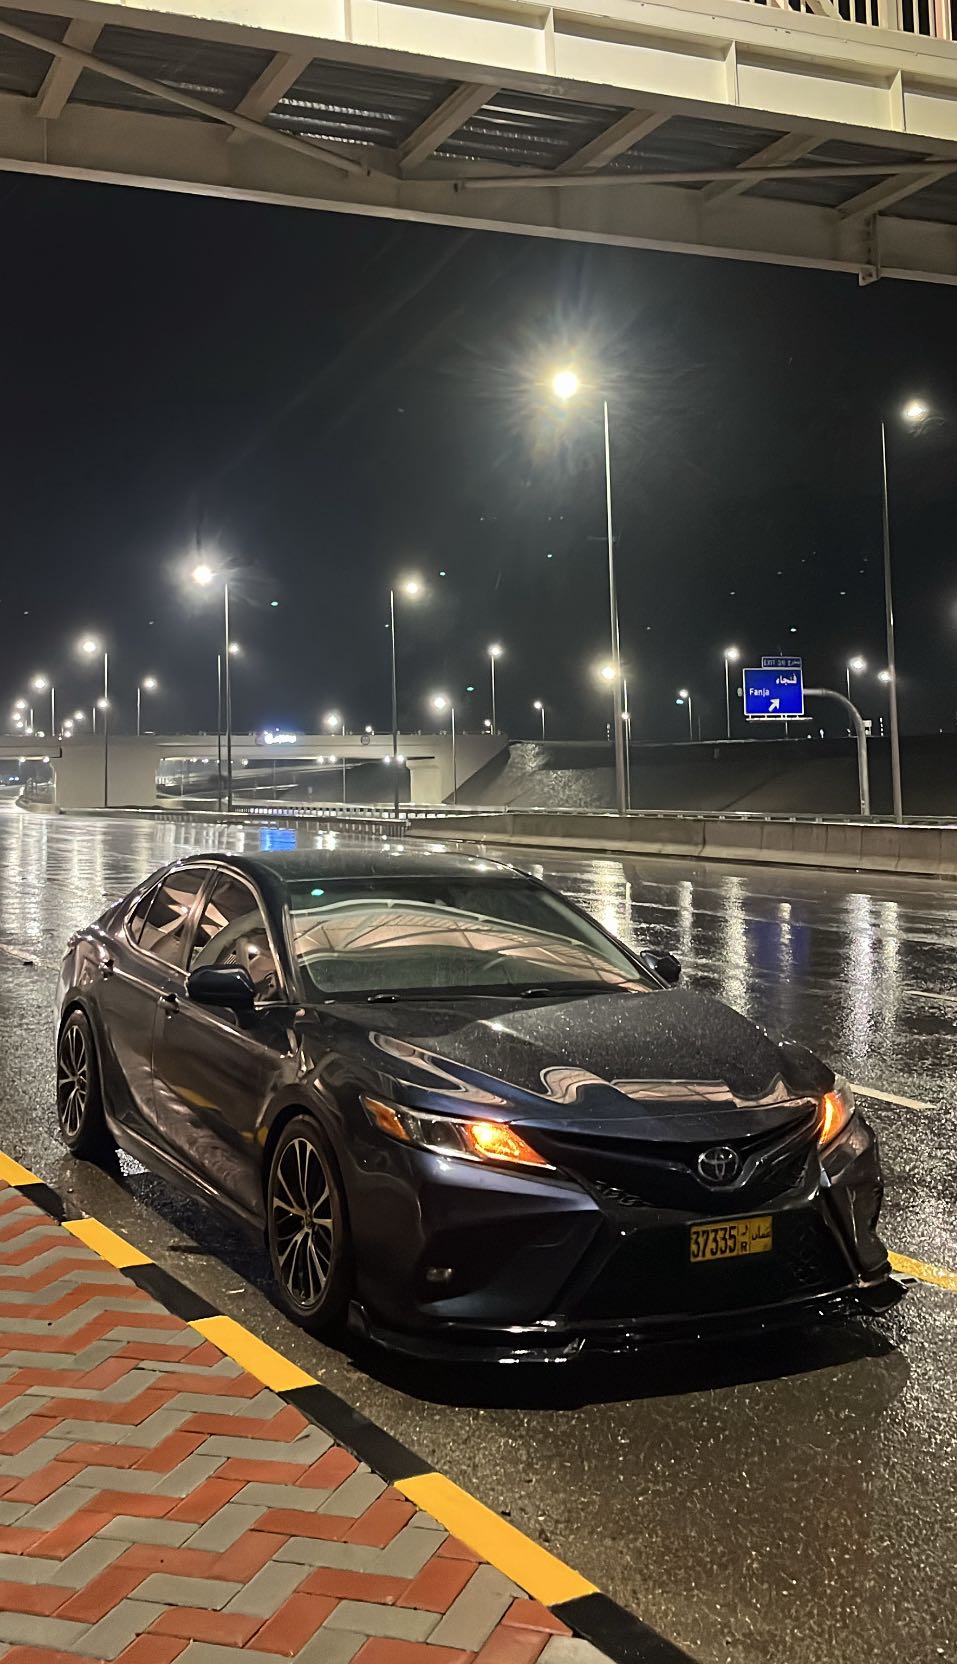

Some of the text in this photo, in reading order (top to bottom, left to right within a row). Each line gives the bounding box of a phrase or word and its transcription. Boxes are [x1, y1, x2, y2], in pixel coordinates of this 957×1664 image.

[776, 673, 797, 685] فنجاء
[749, 688, 770, 697] Fanja
[692, 1225, 737, 1258] 37335
[740, 1241, 748, 1252] R
